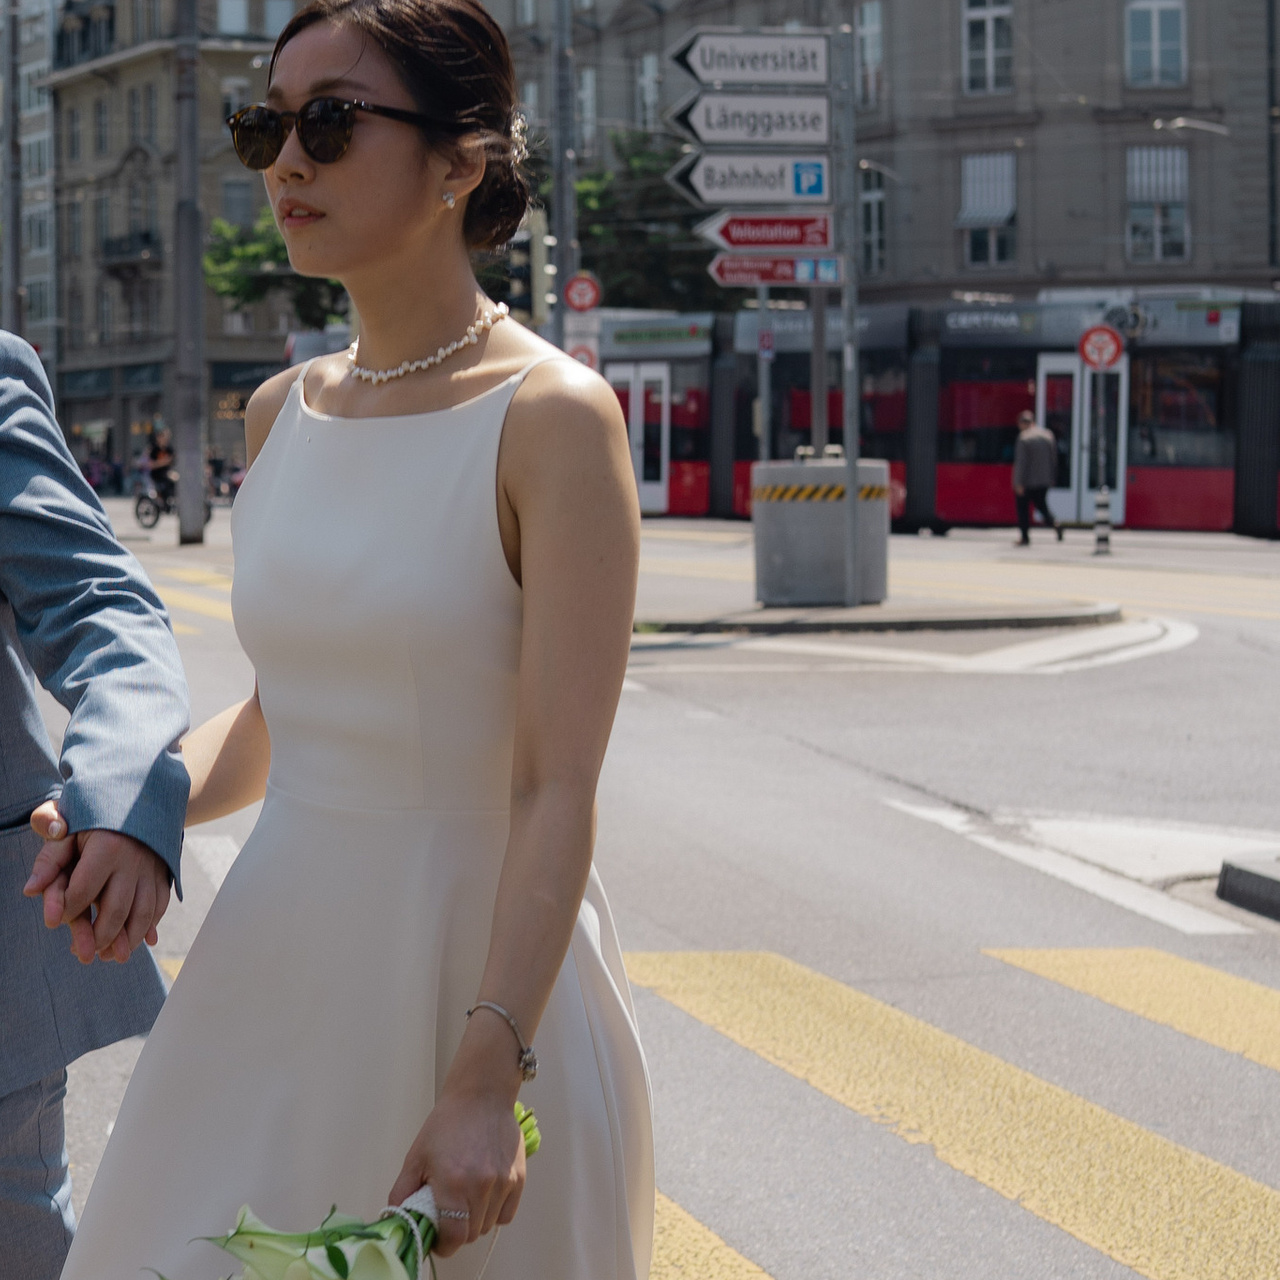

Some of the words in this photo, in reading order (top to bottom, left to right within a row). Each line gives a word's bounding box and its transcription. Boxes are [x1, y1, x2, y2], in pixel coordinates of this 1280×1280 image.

[699, 45, 819, 71] Universität
[703, 104, 822, 138] Länggasse
[703, 164, 786, 191] Bahnhof
[728, 221, 801, 241] Velostation
[946, 311, 1019, 329] CERTINA
